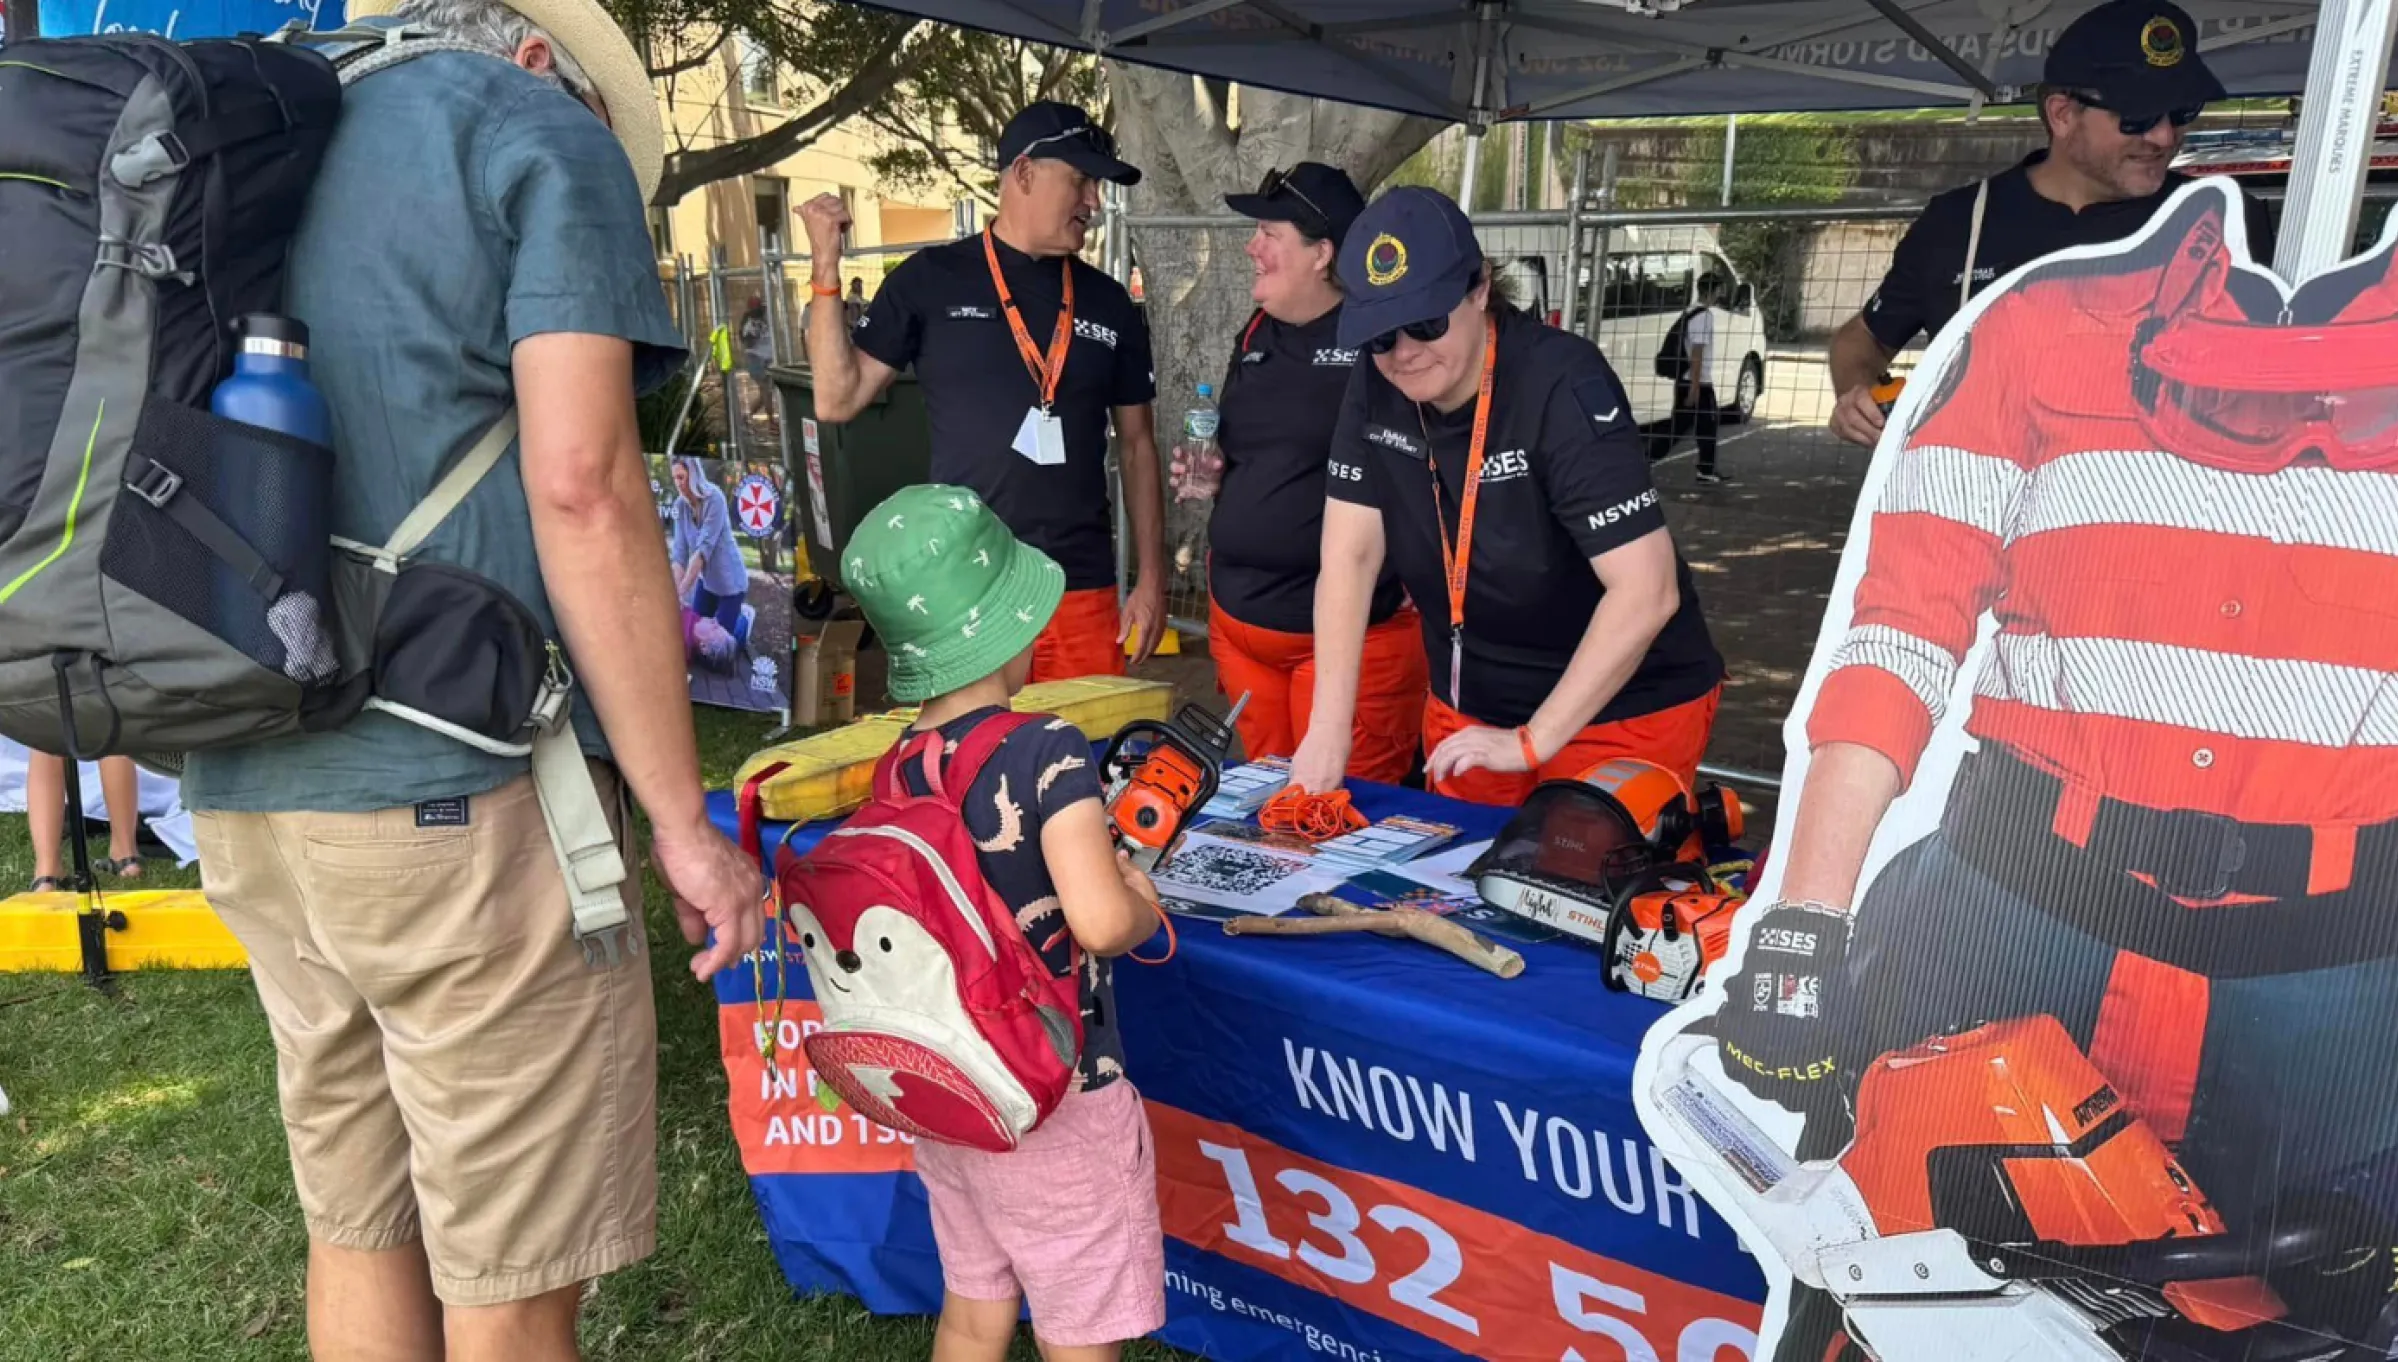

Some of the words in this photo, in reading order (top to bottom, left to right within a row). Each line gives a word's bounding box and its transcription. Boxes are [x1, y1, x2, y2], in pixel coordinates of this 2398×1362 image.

[1567, 909, 1606, 932] STIHL
[764, 1115, 843, 1146] AND
[1283, 1037, 1476, 1162] KNOW
[1495, 1100, 1700, 1239] YOUR
[1198, 1139, 1480, 1337] 132
[1164, 1269, 1226, 1311] ning
